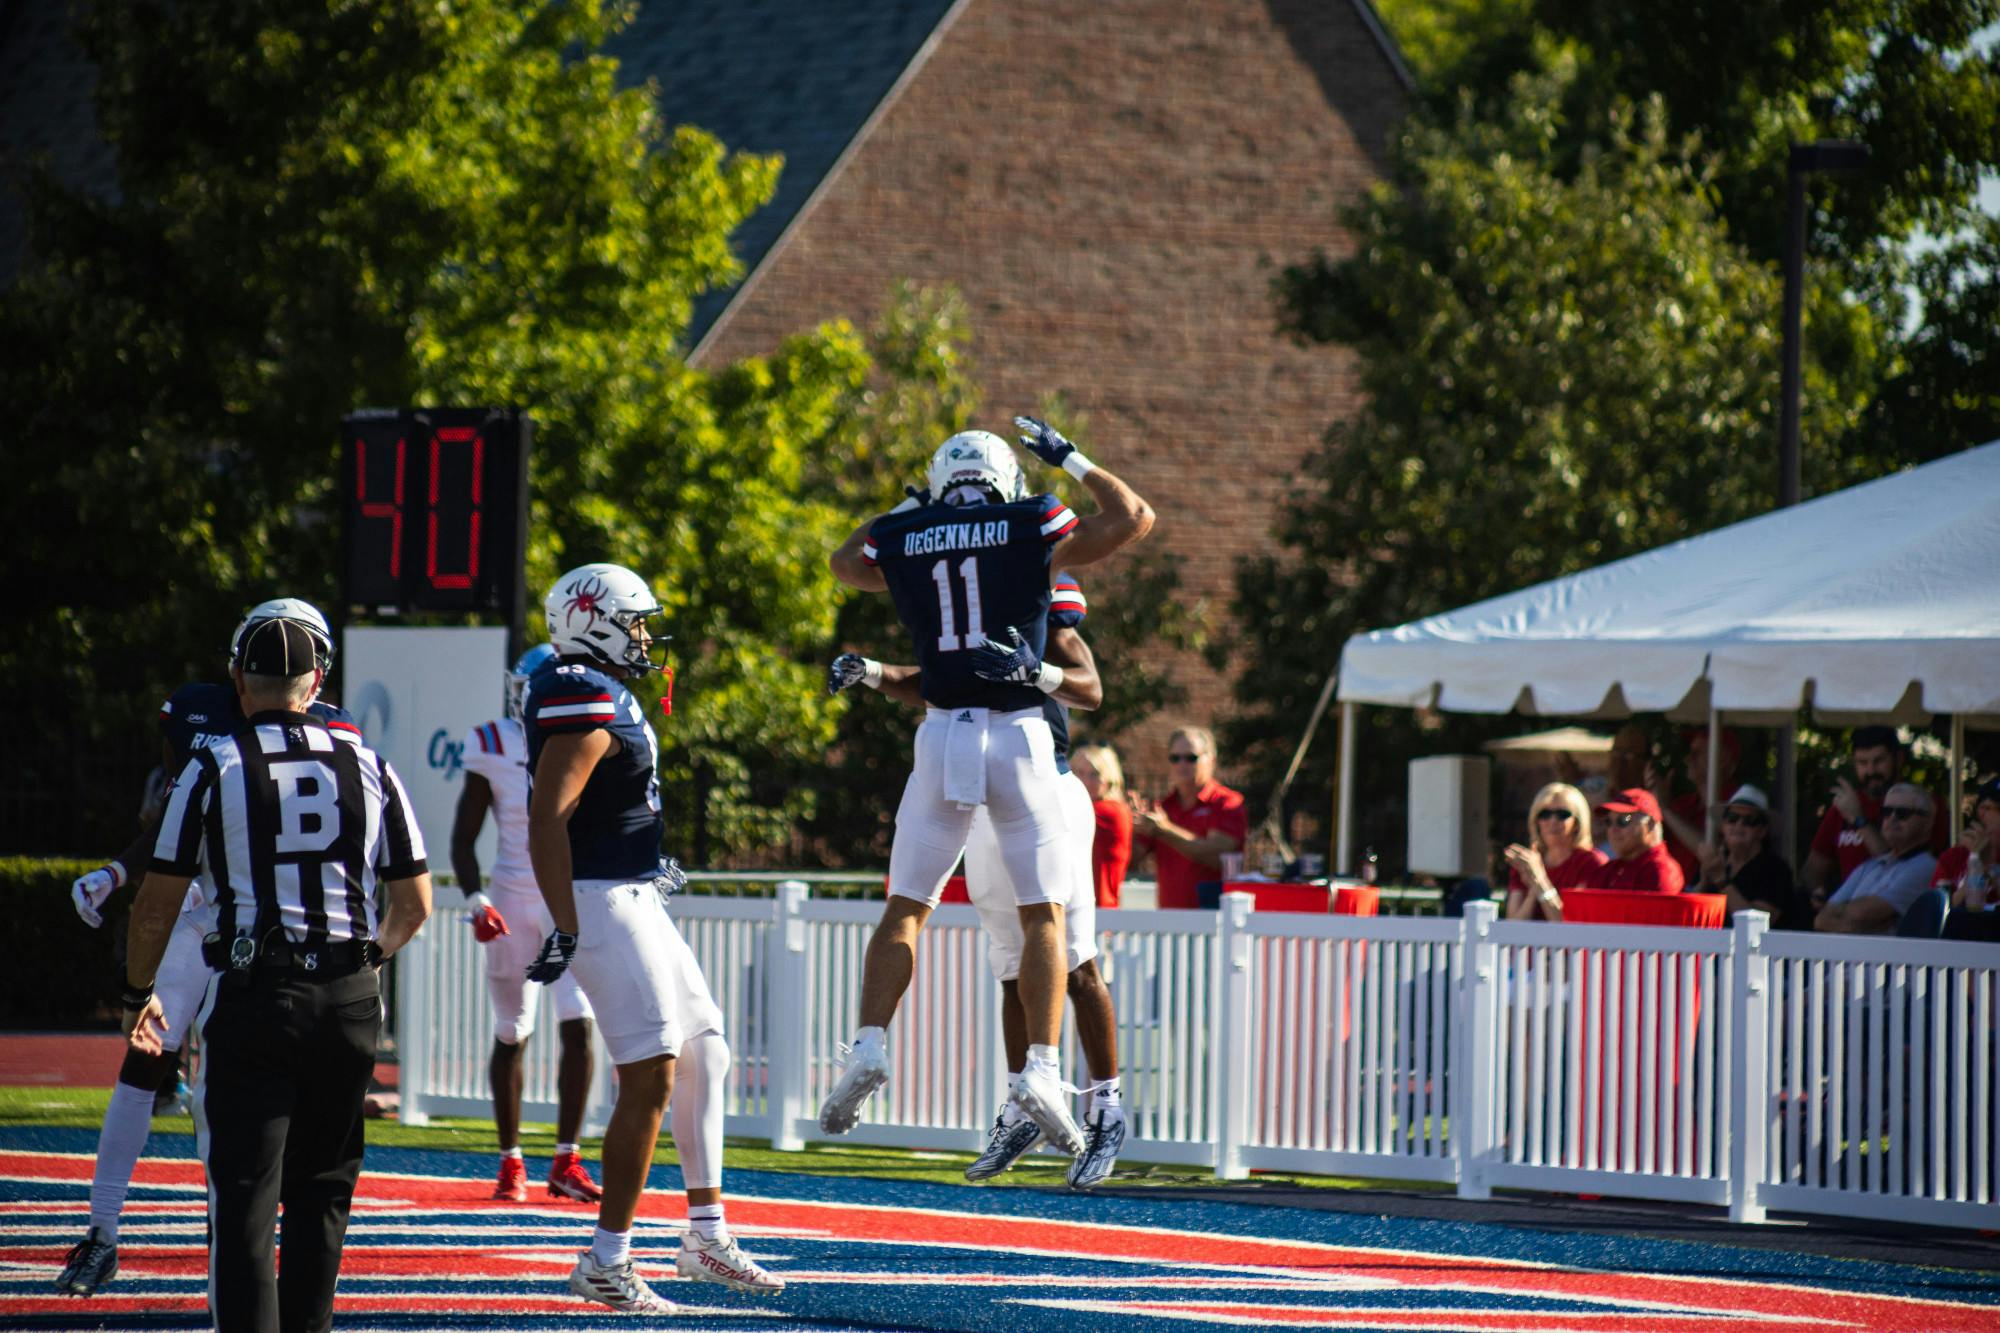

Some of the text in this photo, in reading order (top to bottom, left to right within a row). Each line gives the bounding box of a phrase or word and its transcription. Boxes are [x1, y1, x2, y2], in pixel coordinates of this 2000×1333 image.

[355, 426, 485, 590] 40
[932, 557, 987, 651] 11
[268, 760, 340, 854] B
